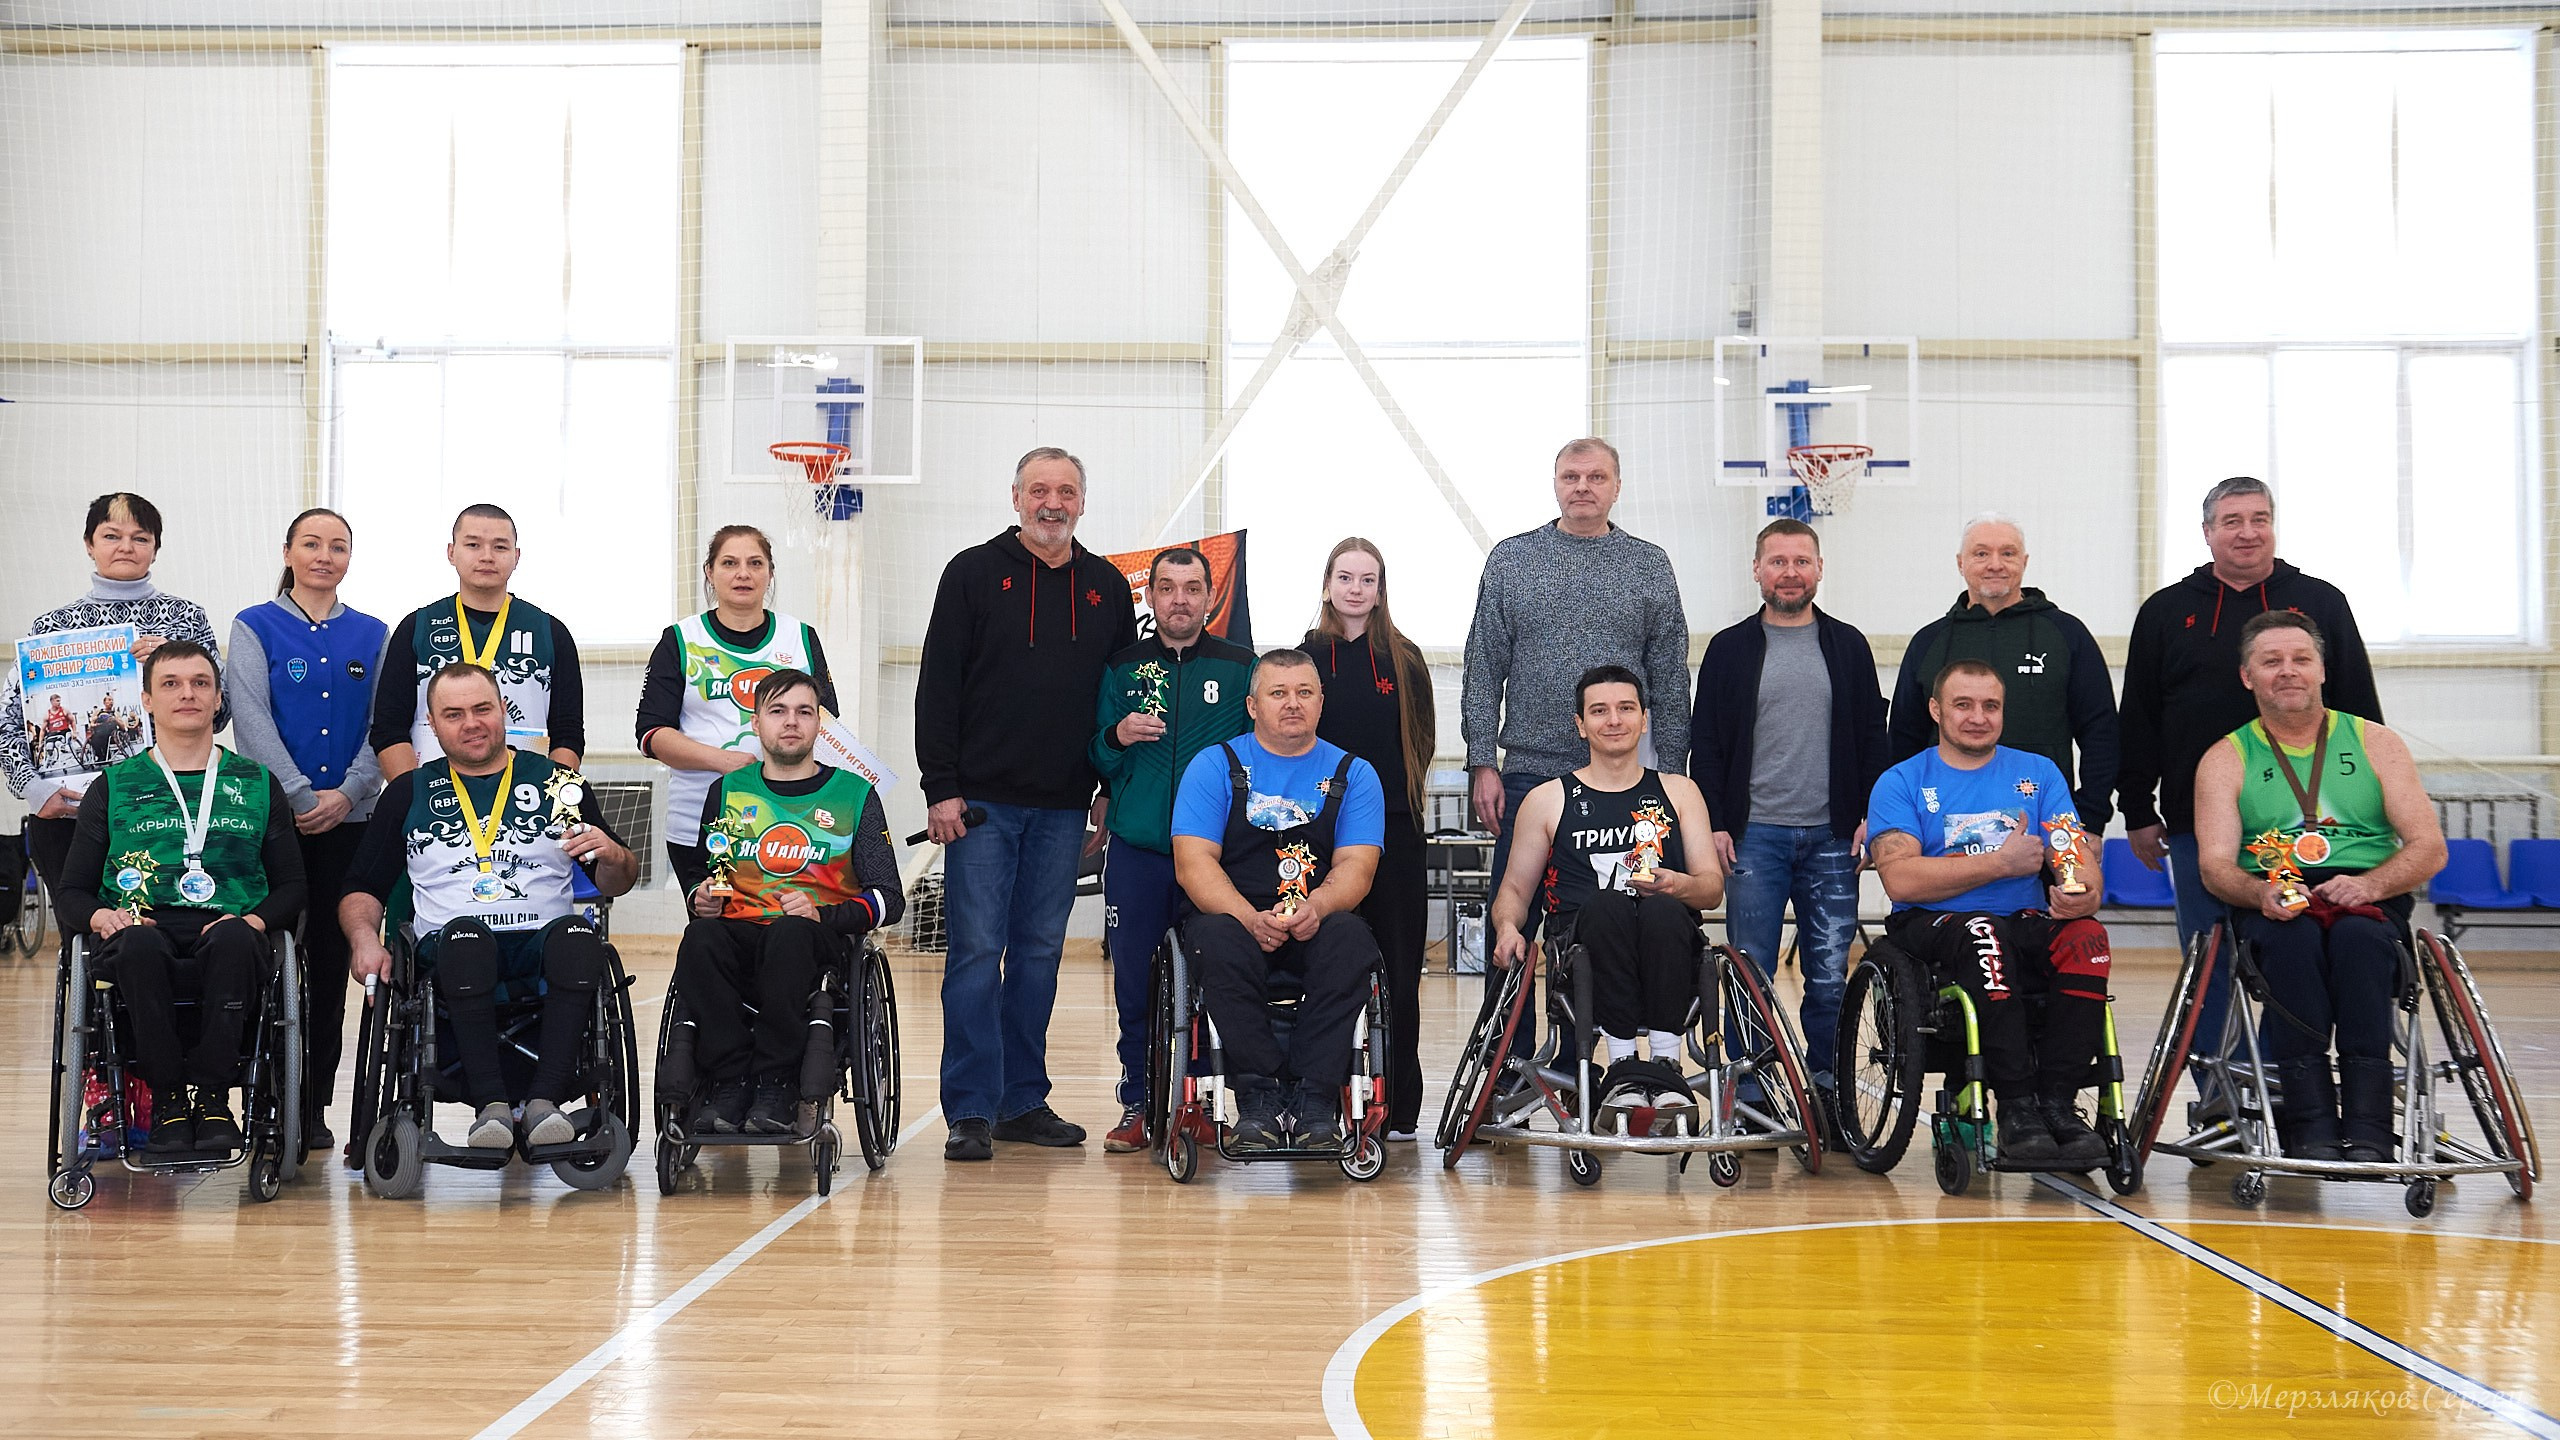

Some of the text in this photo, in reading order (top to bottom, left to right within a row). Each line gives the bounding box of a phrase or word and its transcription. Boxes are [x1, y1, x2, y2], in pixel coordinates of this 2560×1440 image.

[30, 637, 127, 662] РОЖДЕСТВЕНСКИЙ
[434, 635, 457, 643] RBF
[43, 656, 114, 677] ТУРНИР 2024
[710, 680, 732, 696] ЯР
[1203, 680, 1219, 704] 8
[818, 726, 847, 755] ЖИВИ
[846, 753, 881, 786] ИГРОЙ!
[2340, 752, 2357, 776] 5
[434, 797, 458, 809] RBF
[514, 783, 541, 812] 9
[491, 849, 511, 862] THE
[738, 839, 826, 860] ЯР ЧАЛЛЫ
[451, 931, 478, 940] MIKASA
[567, 925, 593, 934] MIKASA
